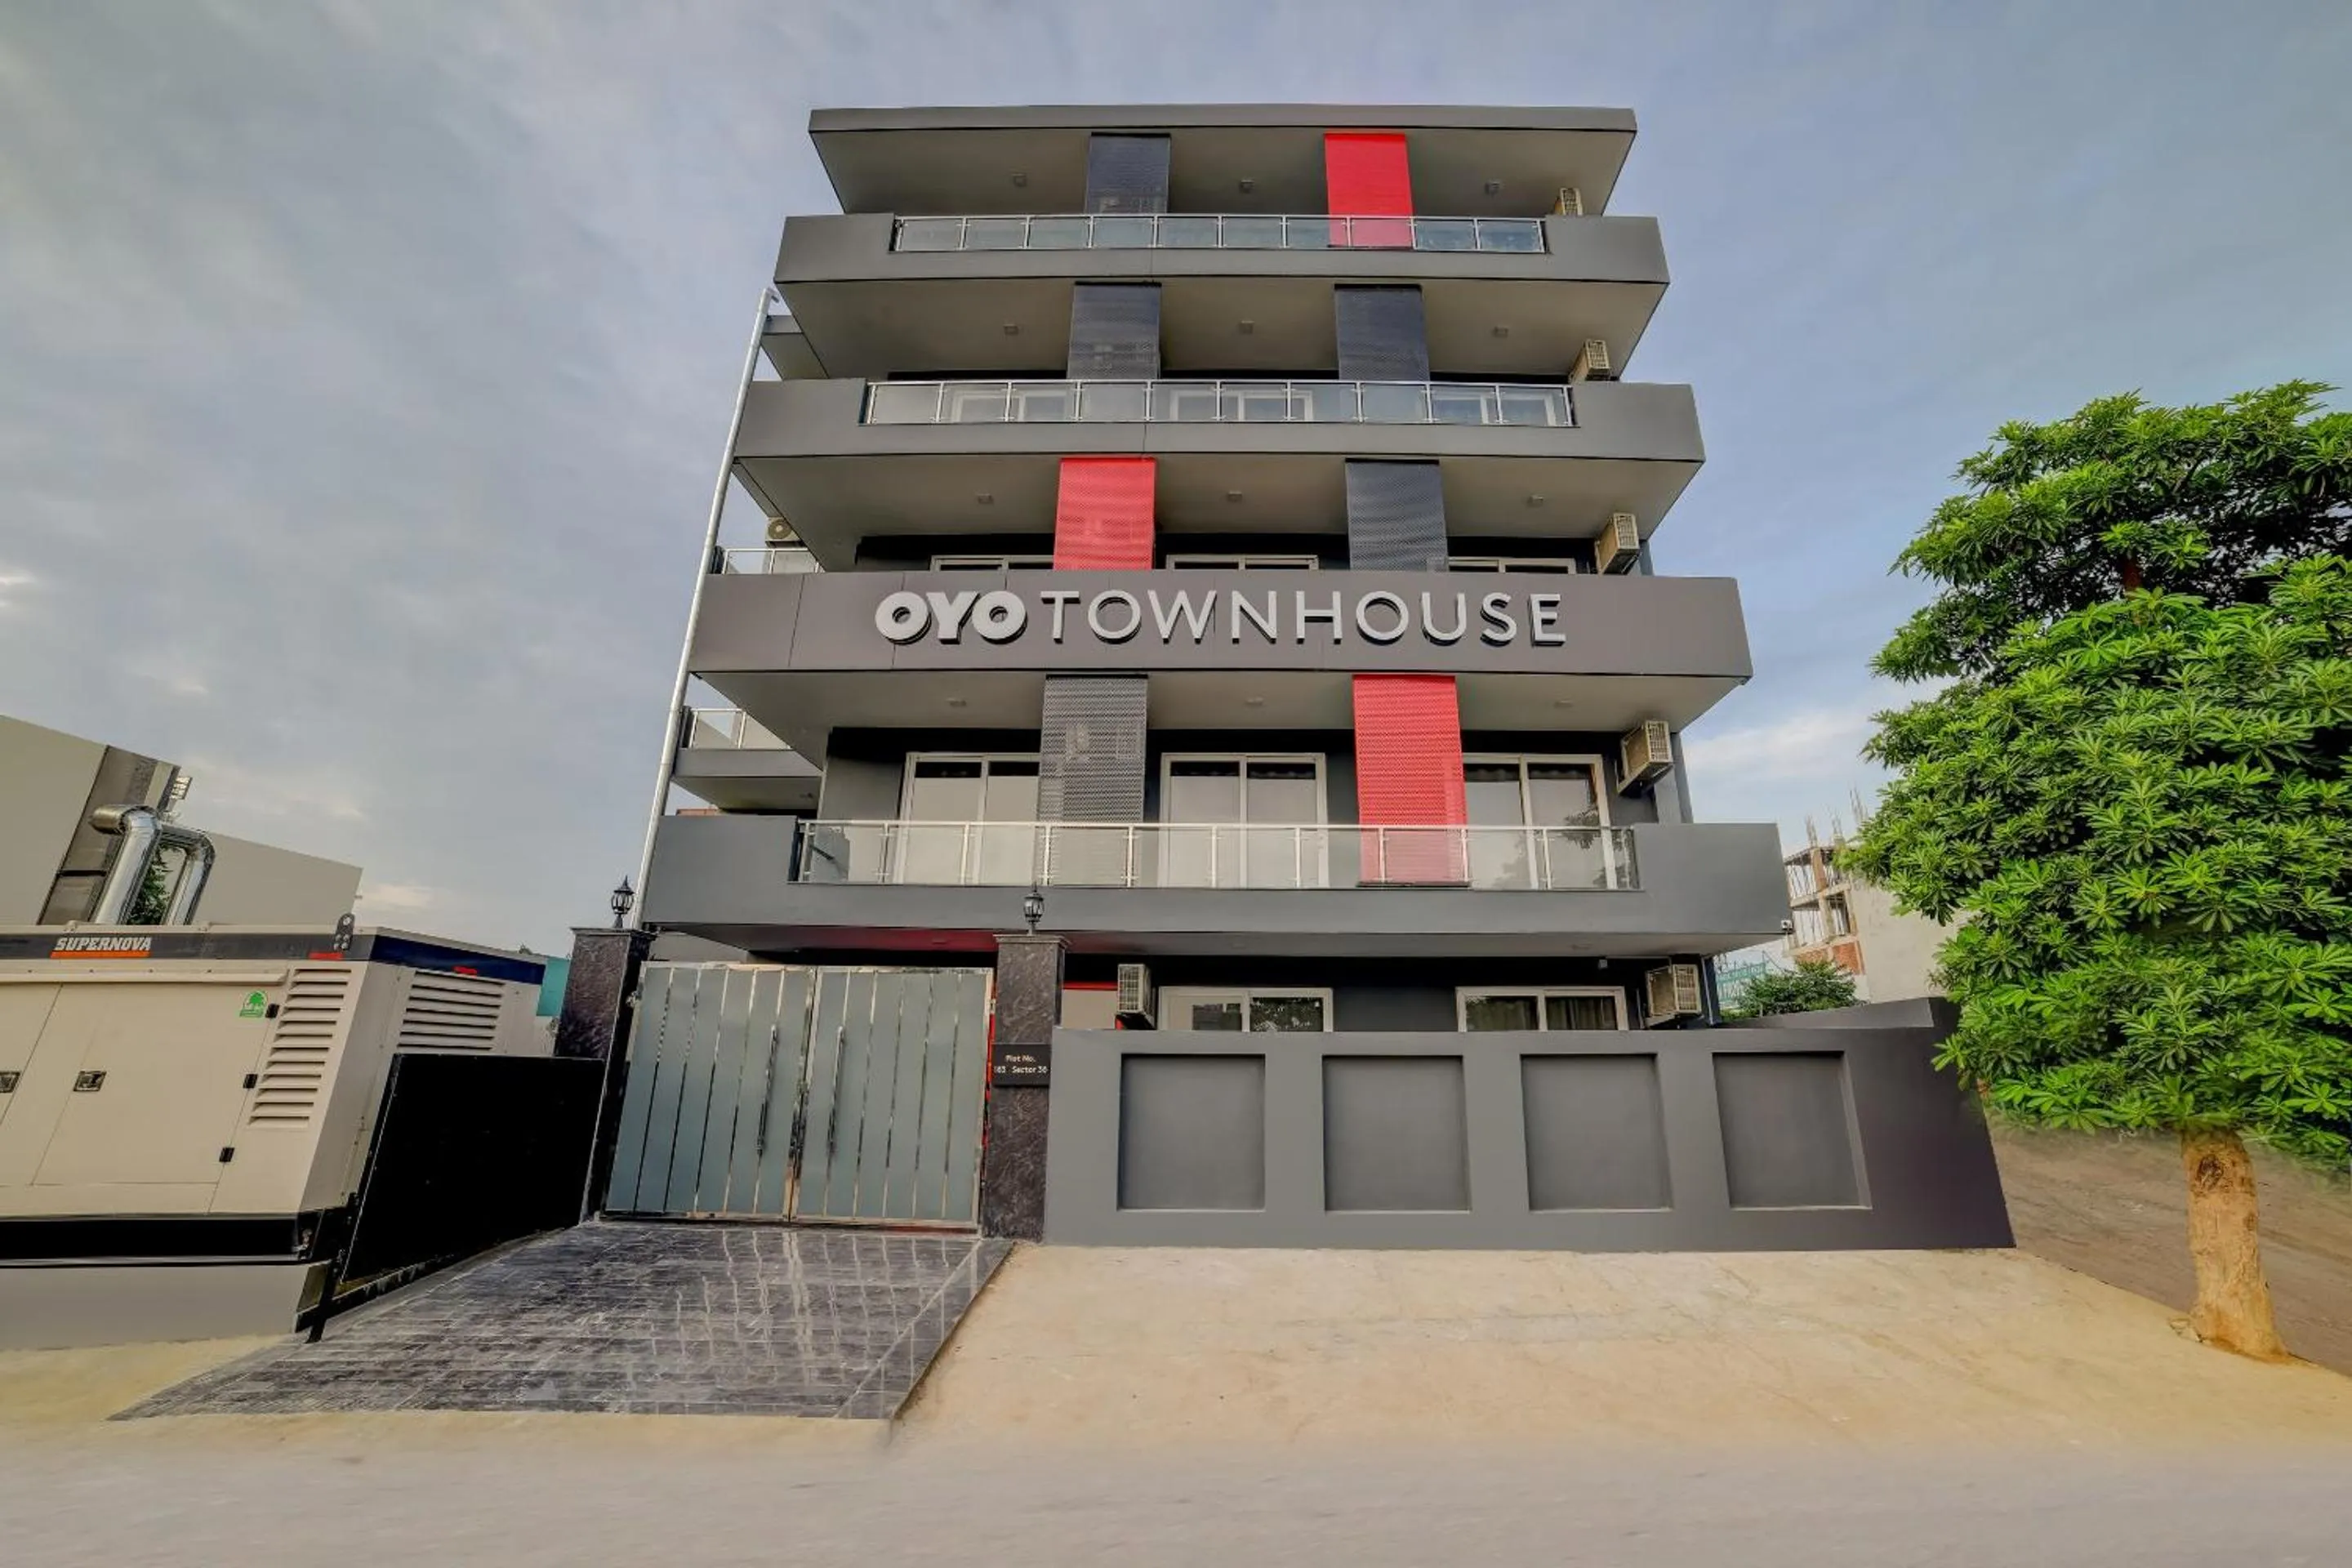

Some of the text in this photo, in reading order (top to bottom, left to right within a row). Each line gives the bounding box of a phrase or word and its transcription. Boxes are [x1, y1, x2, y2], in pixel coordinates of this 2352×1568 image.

[875, 590, 1566, 648] OYO TOWNHOUSE
[53, 937, 152, 951] SUPERNOVA
[1012, 1065, 1036, 1073] Sector
